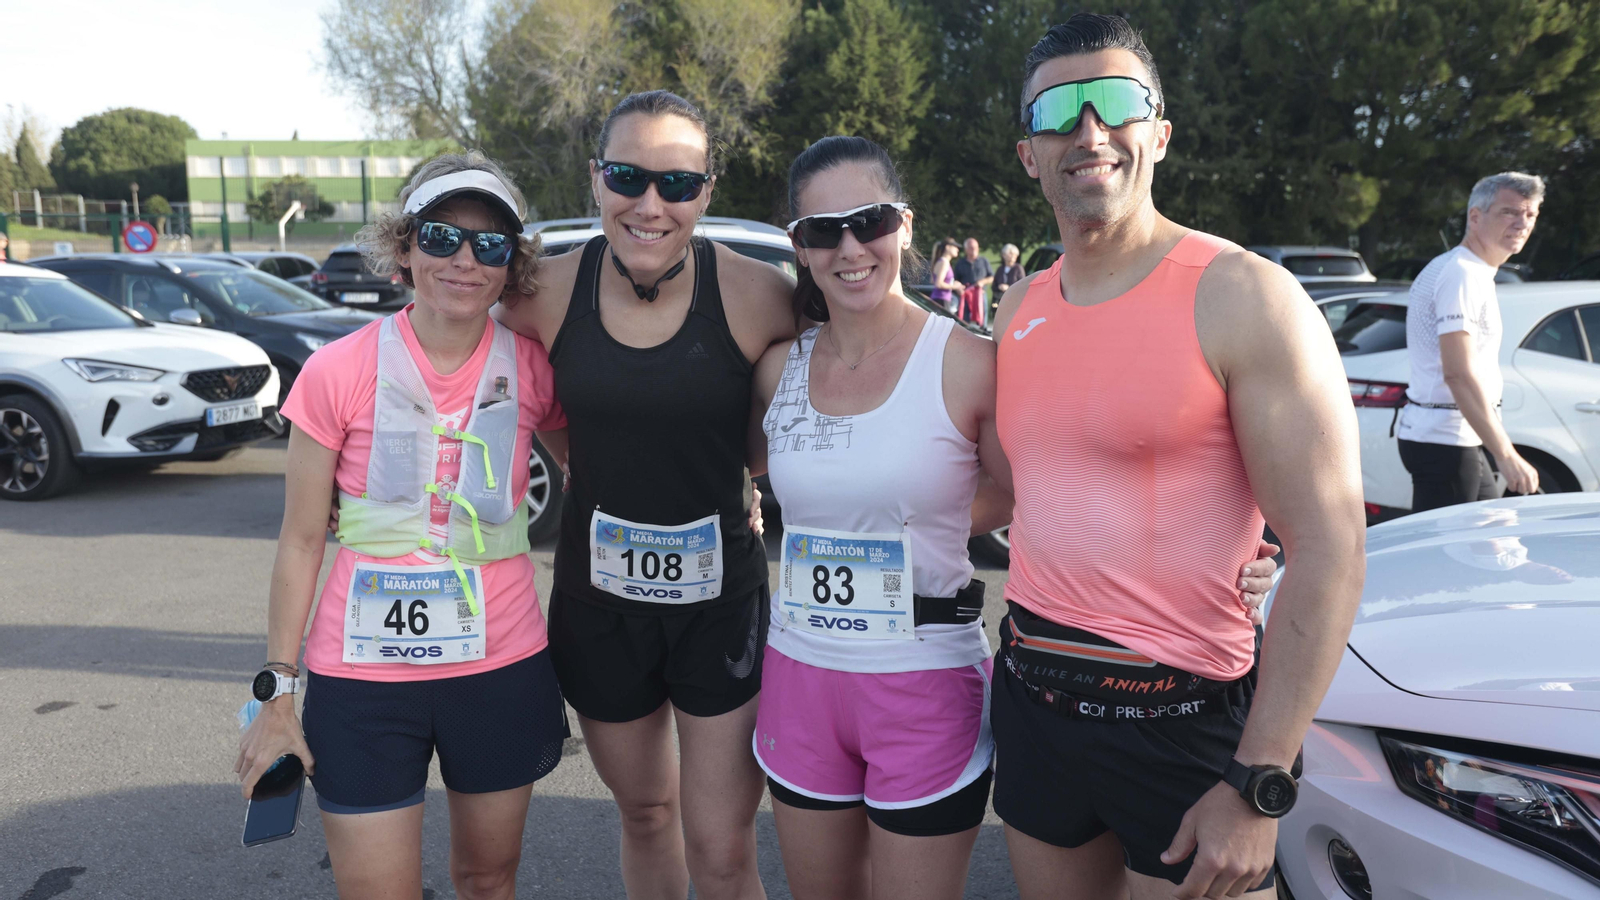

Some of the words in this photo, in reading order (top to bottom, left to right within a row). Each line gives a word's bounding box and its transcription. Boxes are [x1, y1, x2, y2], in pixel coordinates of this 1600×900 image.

[215, 406, 241, 423] 2877
[629, 533, 684, 546] MARATÓN
[687, 537, 705, 545] MARZO
[811, 544, 865, 557] MARATÓN
[621, 548, 683, 582] 108
[383, 577, 440, 590] MARATÓN
[812, 564, 855, 606] 83
[622, 584, 683, 599] EVOS
[889, 600, 895, 608] S
[383, 599, 430, 636] 46
[807, 614, 868, 631] EVOS
[461, 625, 472, 633] XS
[379, 645, 443, 659] EVOS
[1034, 664, 1068, 680] LIKE
[1073, 672, 1096, 685] AN
[1099, 675, 1177, 694] ANIMAL
